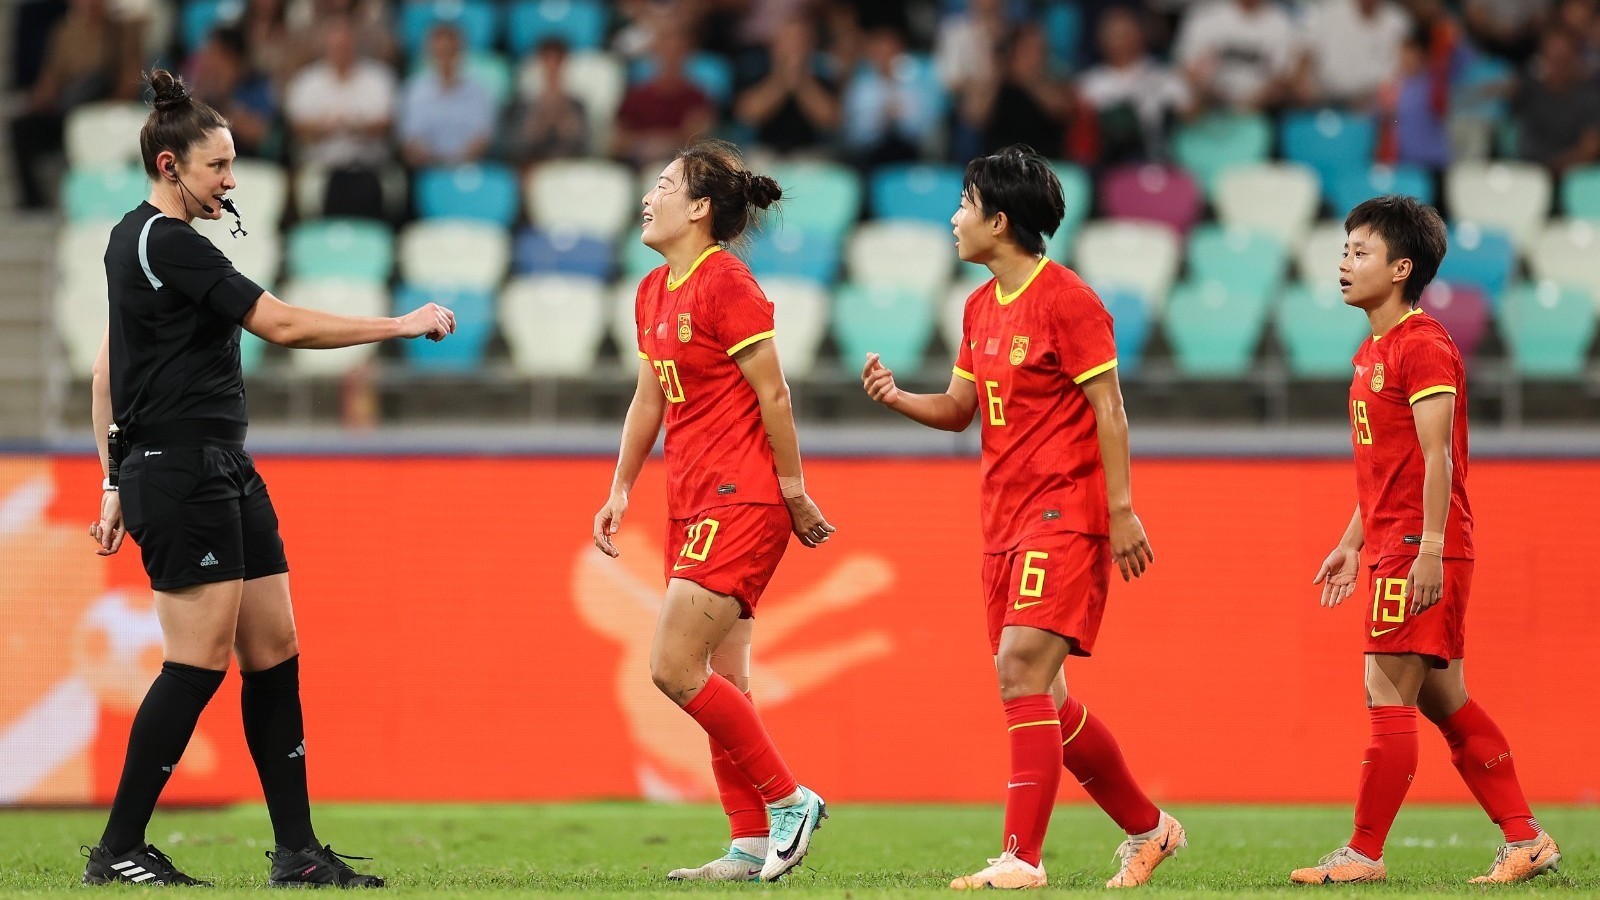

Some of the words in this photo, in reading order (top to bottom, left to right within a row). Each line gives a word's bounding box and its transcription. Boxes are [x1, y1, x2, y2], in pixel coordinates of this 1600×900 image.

[653, 360, 686, 404] 20
[985, 381, 1006, 426] 6
[1352, 400, 1373, 445] 19
[1019, 551, 1048, 598] 6
[1372, 577, 1408, 623] 19
[1484, 750, 1512, 769] CF
